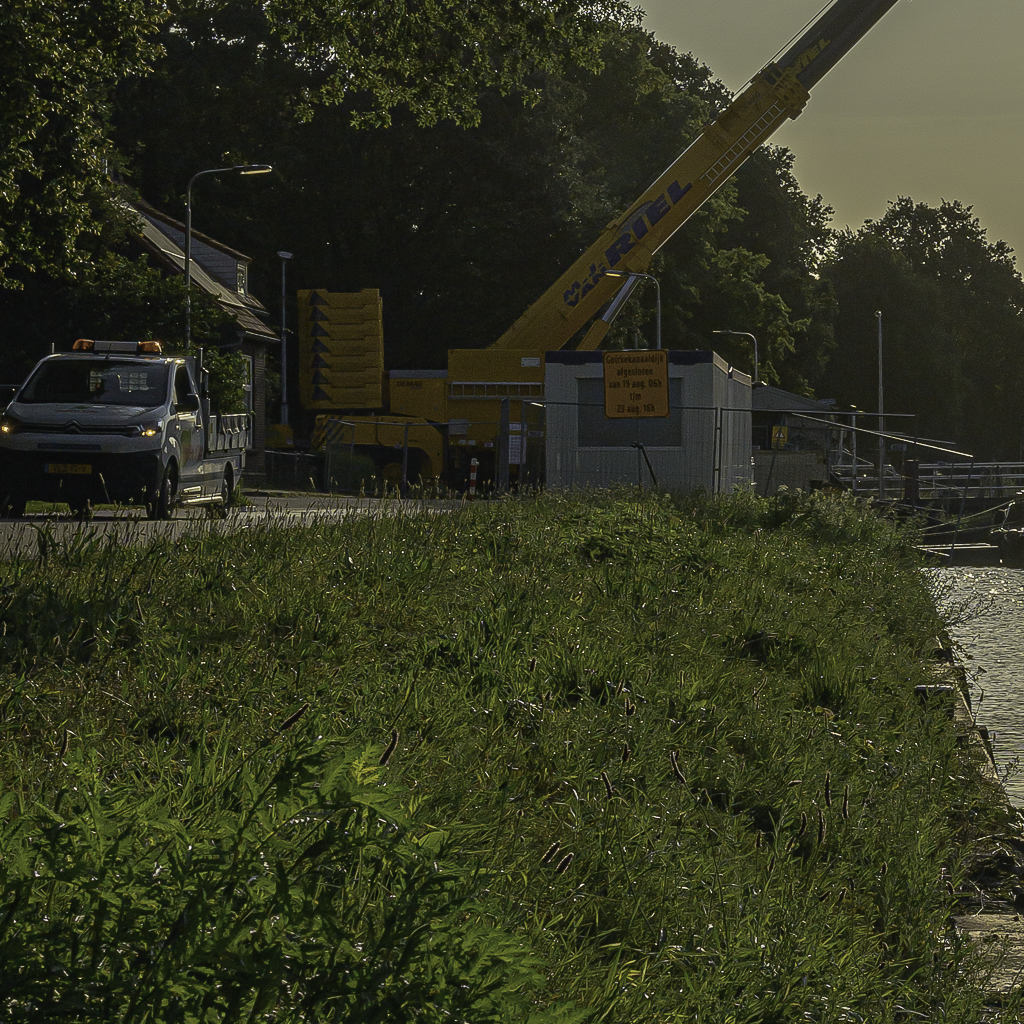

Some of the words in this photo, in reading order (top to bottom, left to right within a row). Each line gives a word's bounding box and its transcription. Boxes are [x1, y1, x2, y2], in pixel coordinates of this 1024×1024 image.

[605, 180, 693, 268] RIEL
[567, 266, 607, 307] VAN
[616, 367, 653, 377] afgesloten
[622, 379, 630, 388] 19
[632, 380, 646, 390] aug.
